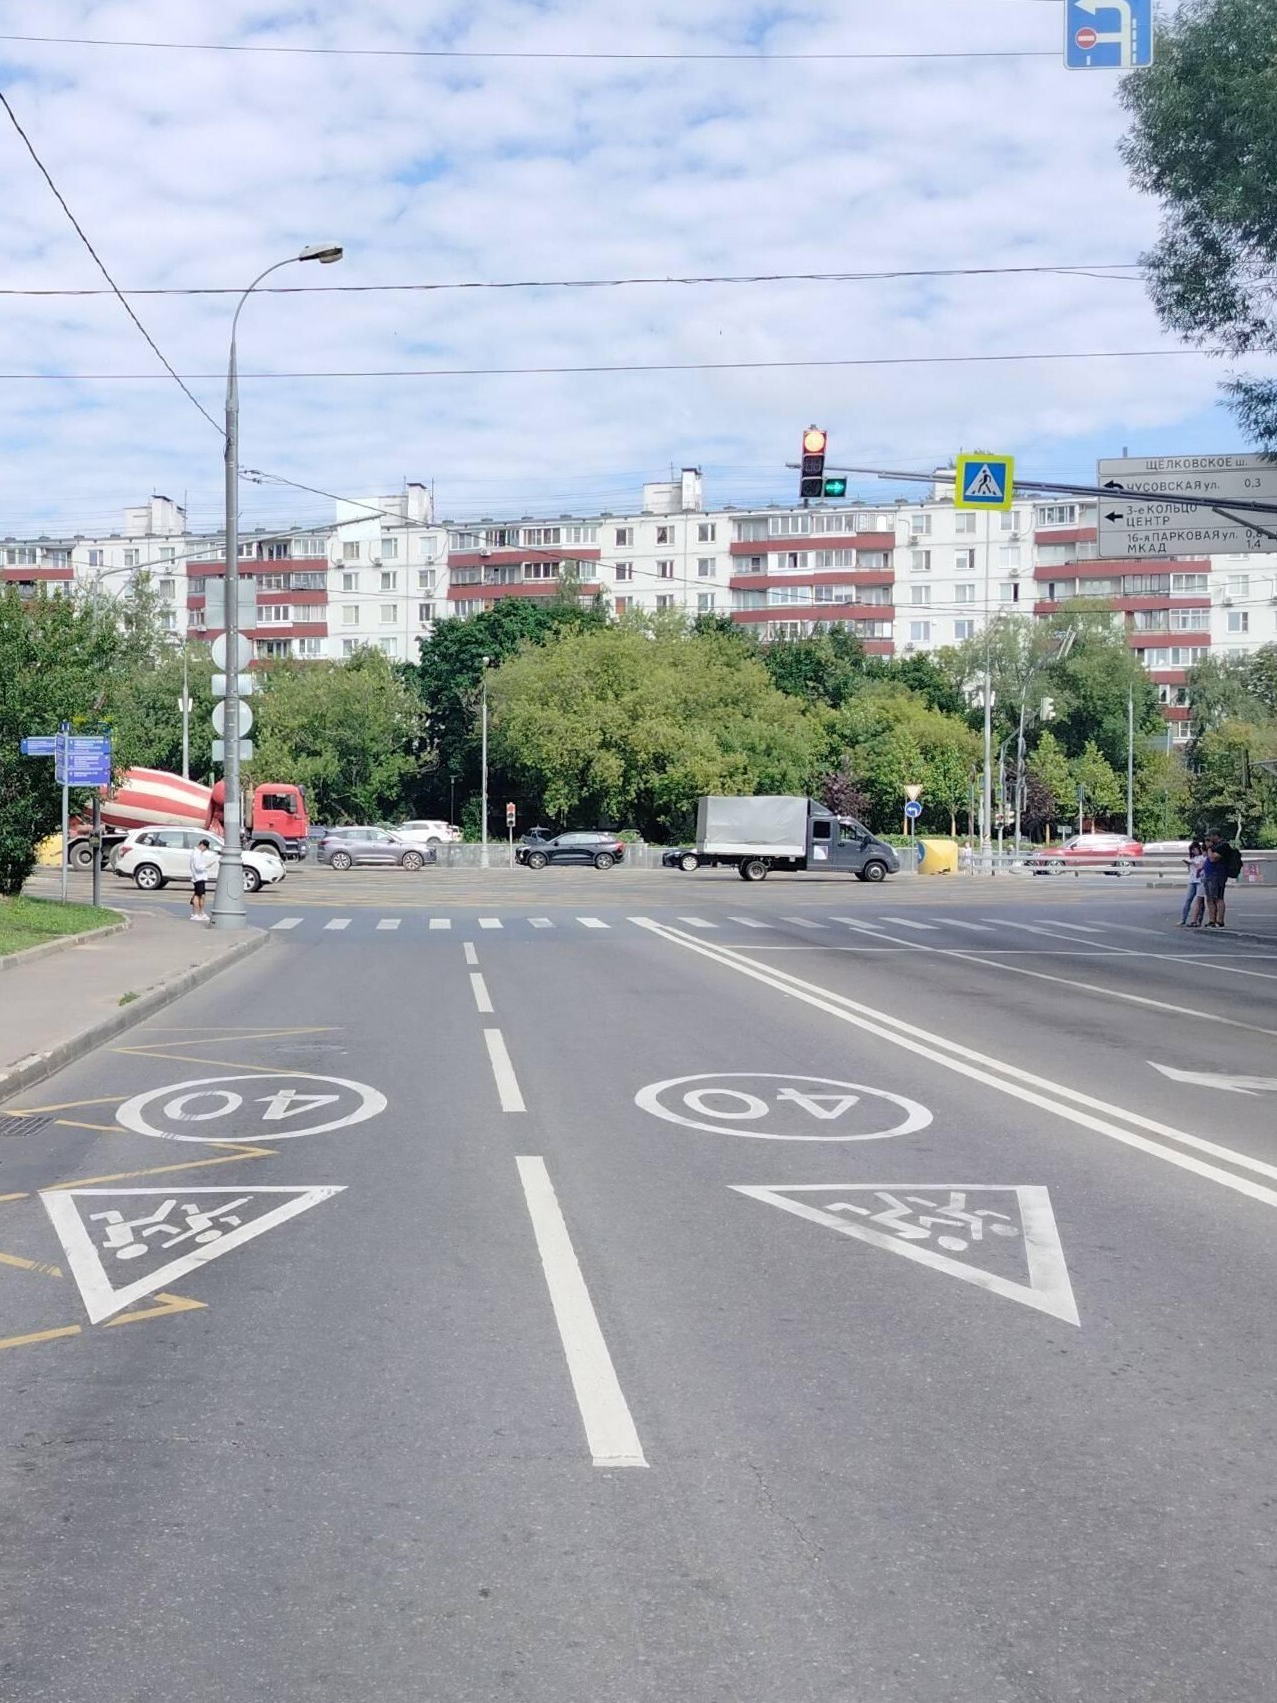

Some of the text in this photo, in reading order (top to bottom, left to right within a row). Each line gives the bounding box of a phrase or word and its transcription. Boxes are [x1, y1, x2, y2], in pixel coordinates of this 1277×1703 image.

[1127, 481, 1201, 492] ЧУСОВСКАЯ
[1147, 503, 1198, 515] КОЛЬЦО
[1126, 516, 1170, 528] ЦЕНТР
[1152, 530, 1220, 542] ПАРКОВАЯ
[1127, 543, 1167, 553] МКАД
